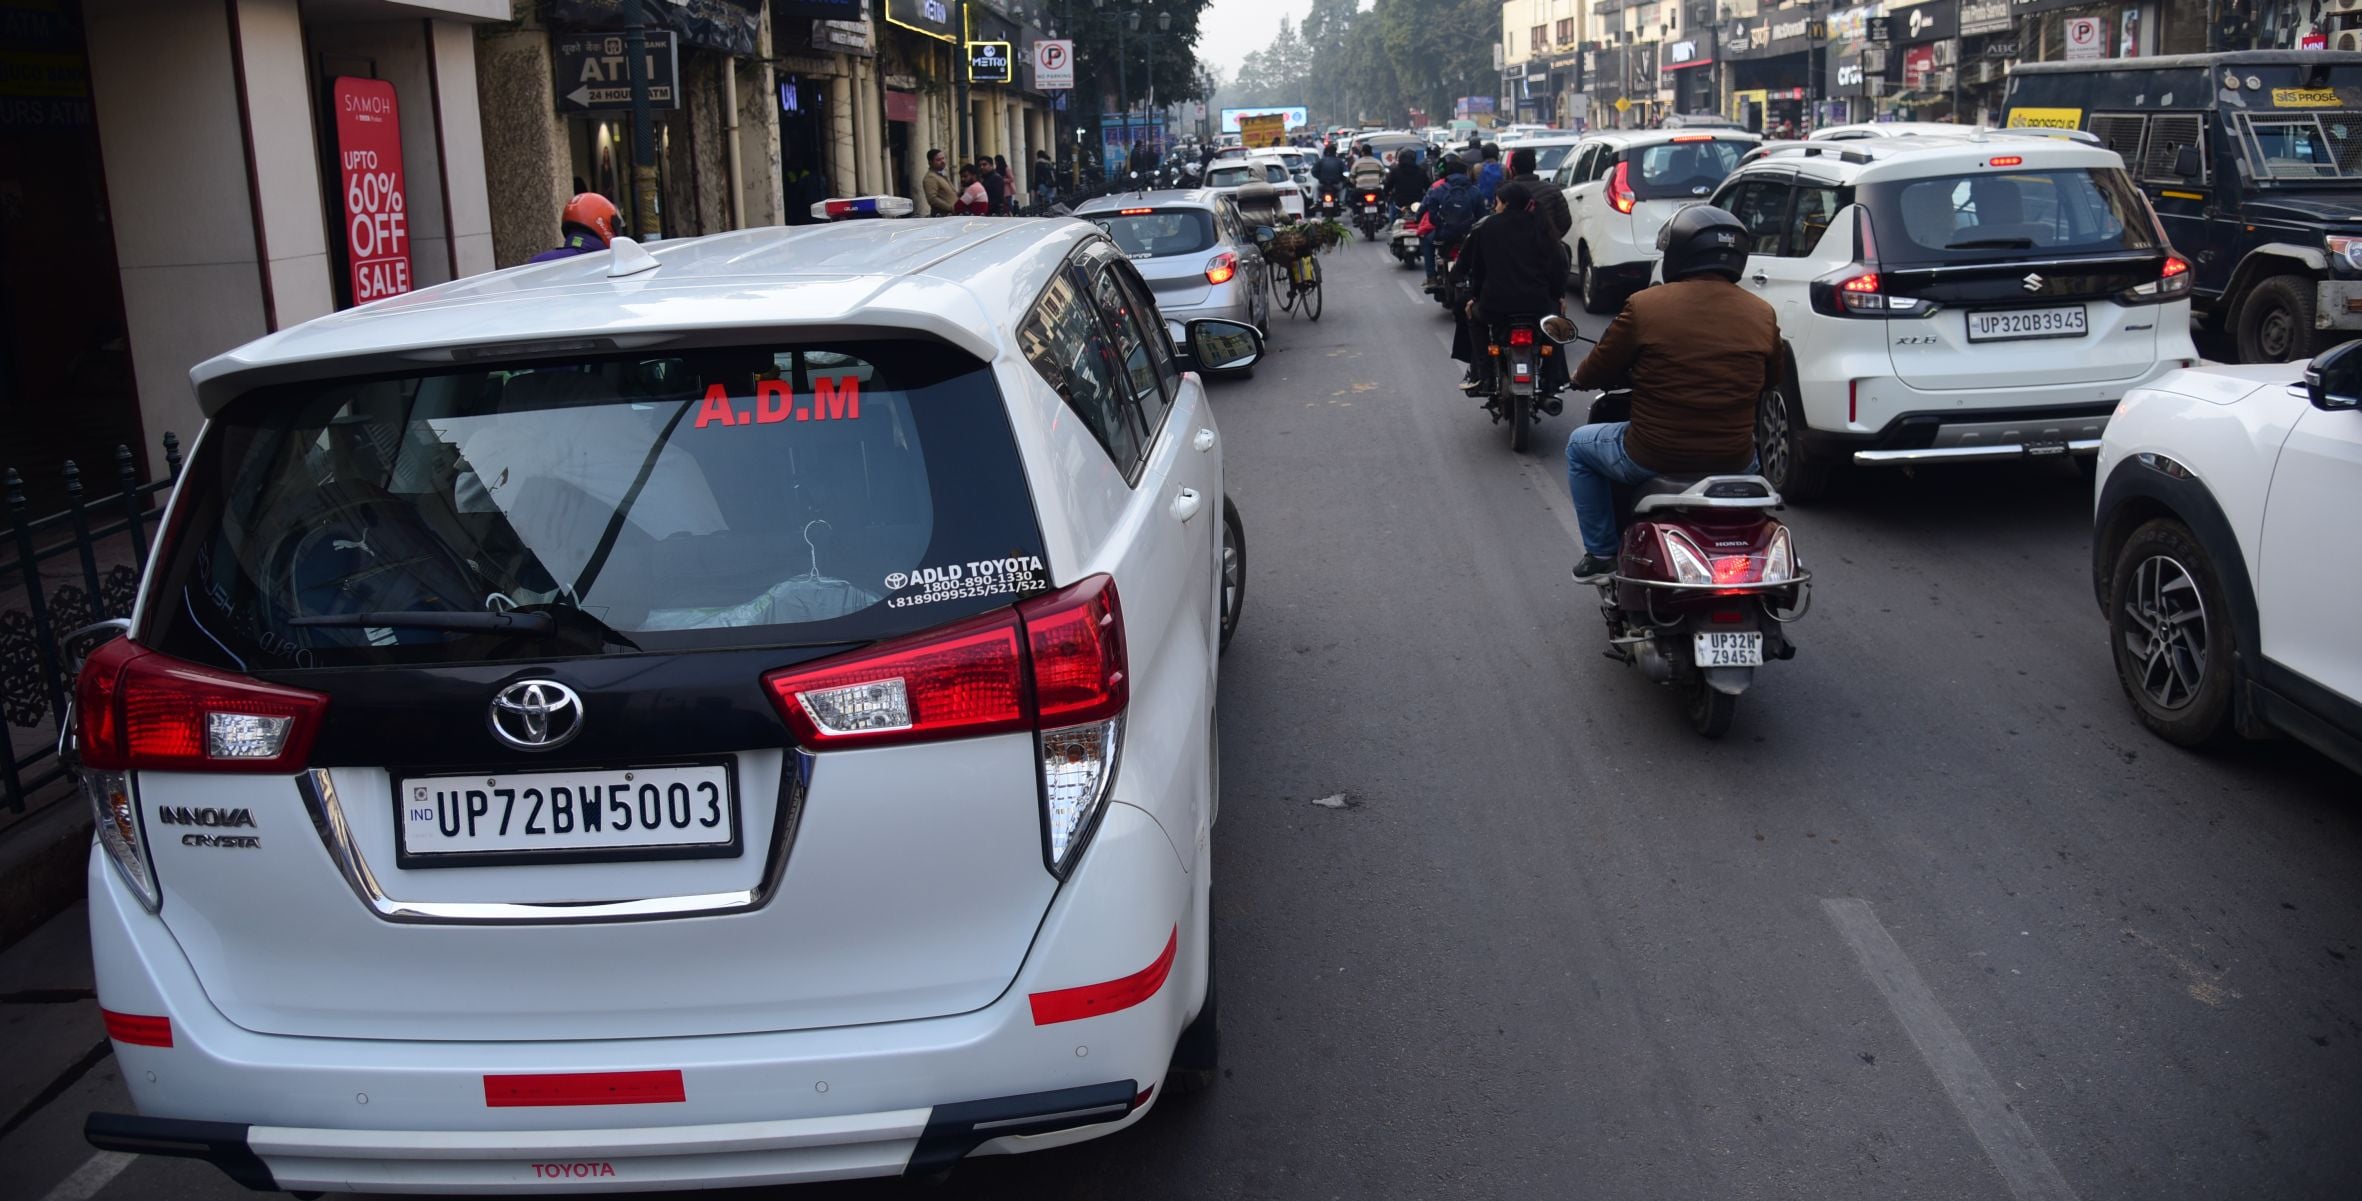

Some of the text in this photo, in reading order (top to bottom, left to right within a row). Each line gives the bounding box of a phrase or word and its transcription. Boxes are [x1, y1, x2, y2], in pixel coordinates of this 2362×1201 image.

[972, 57, 1006, 68] METRO
[344, 94, 390, 114] SAMOH
[589, 91, 602, 100] 24
[605, 89, 632, 100] HOU
[2299, 93, 2341, 102] PROSE
[344, 151, 378, 170] UPTO
[349, 172, 402, 213] 60%
[352, 213, 404, 257] OFF
[359, 262, 407, 298] SALE
[1980, 311, 2084, 334] UP32QB3945
[1896, 336, 1937, 345] XL6
[694, 375, 859, 428] A.D.M
[910, 556, 1044, 586] ADLD TOYOTA
[923, 571, 1033, 593] 1800-890-1330
[896, 579, 1046, 608] 8189099525/521/522
[1711, 634, 1756, 649] UP32H
[159, 805, 257, 828] INNOVA
[410, 808, 433, 821] IND
[437, 781, 721, 838] UP72BW5003
[182, 834, 262, 849] CRYSTA
[531, 1162, 616, 1178] TOYOTA
